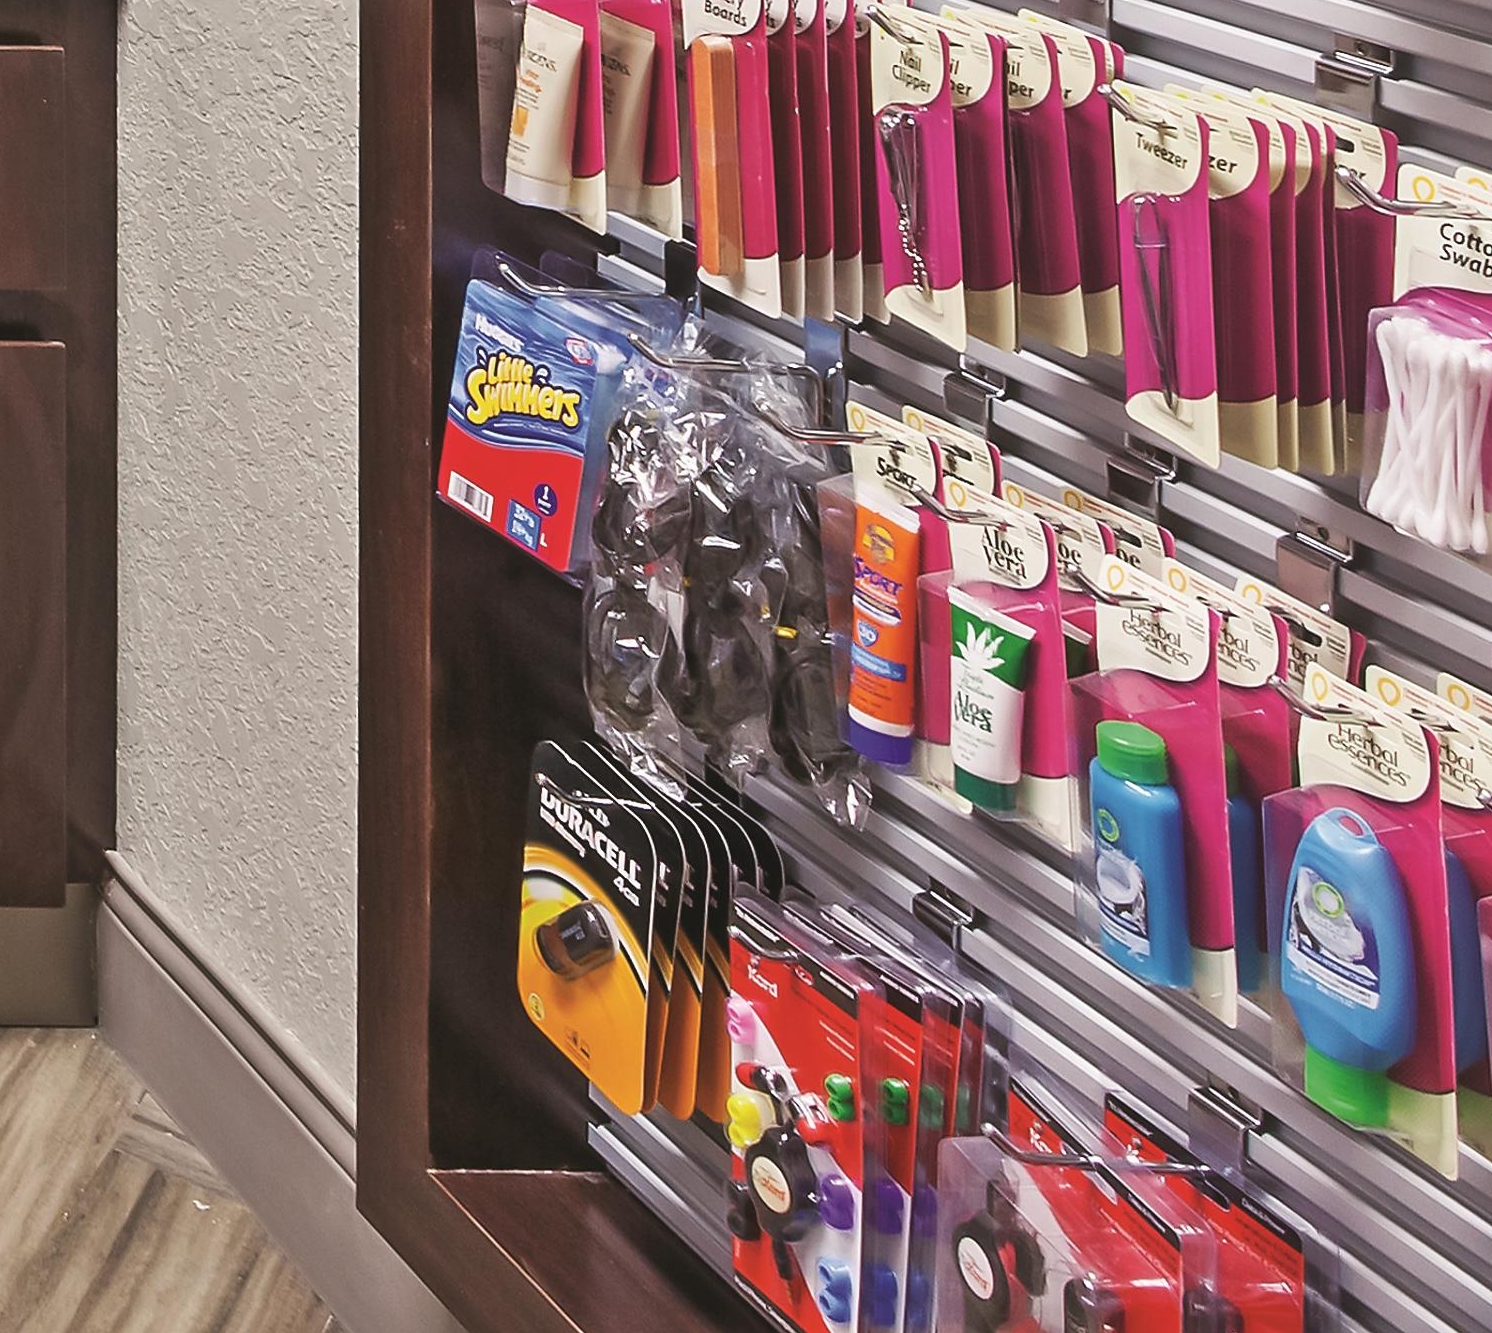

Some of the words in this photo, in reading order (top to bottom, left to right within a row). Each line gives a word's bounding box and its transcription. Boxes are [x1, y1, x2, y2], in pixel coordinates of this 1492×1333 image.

[704, 0, 747, 27] Boards
[892, 64, 931, 94] Clipper
[899, 52, 922, 73] Nail
[1135, 133, 1188, 171] Tweezer
[487, 351, 534, 384] Little
[876, 458, 917, 489] SPORT
[1328, 733, 1409, 787] essences
[1336, 724, 1399, 766] Herbal
[541, 788, 642, 890] DURACELL
